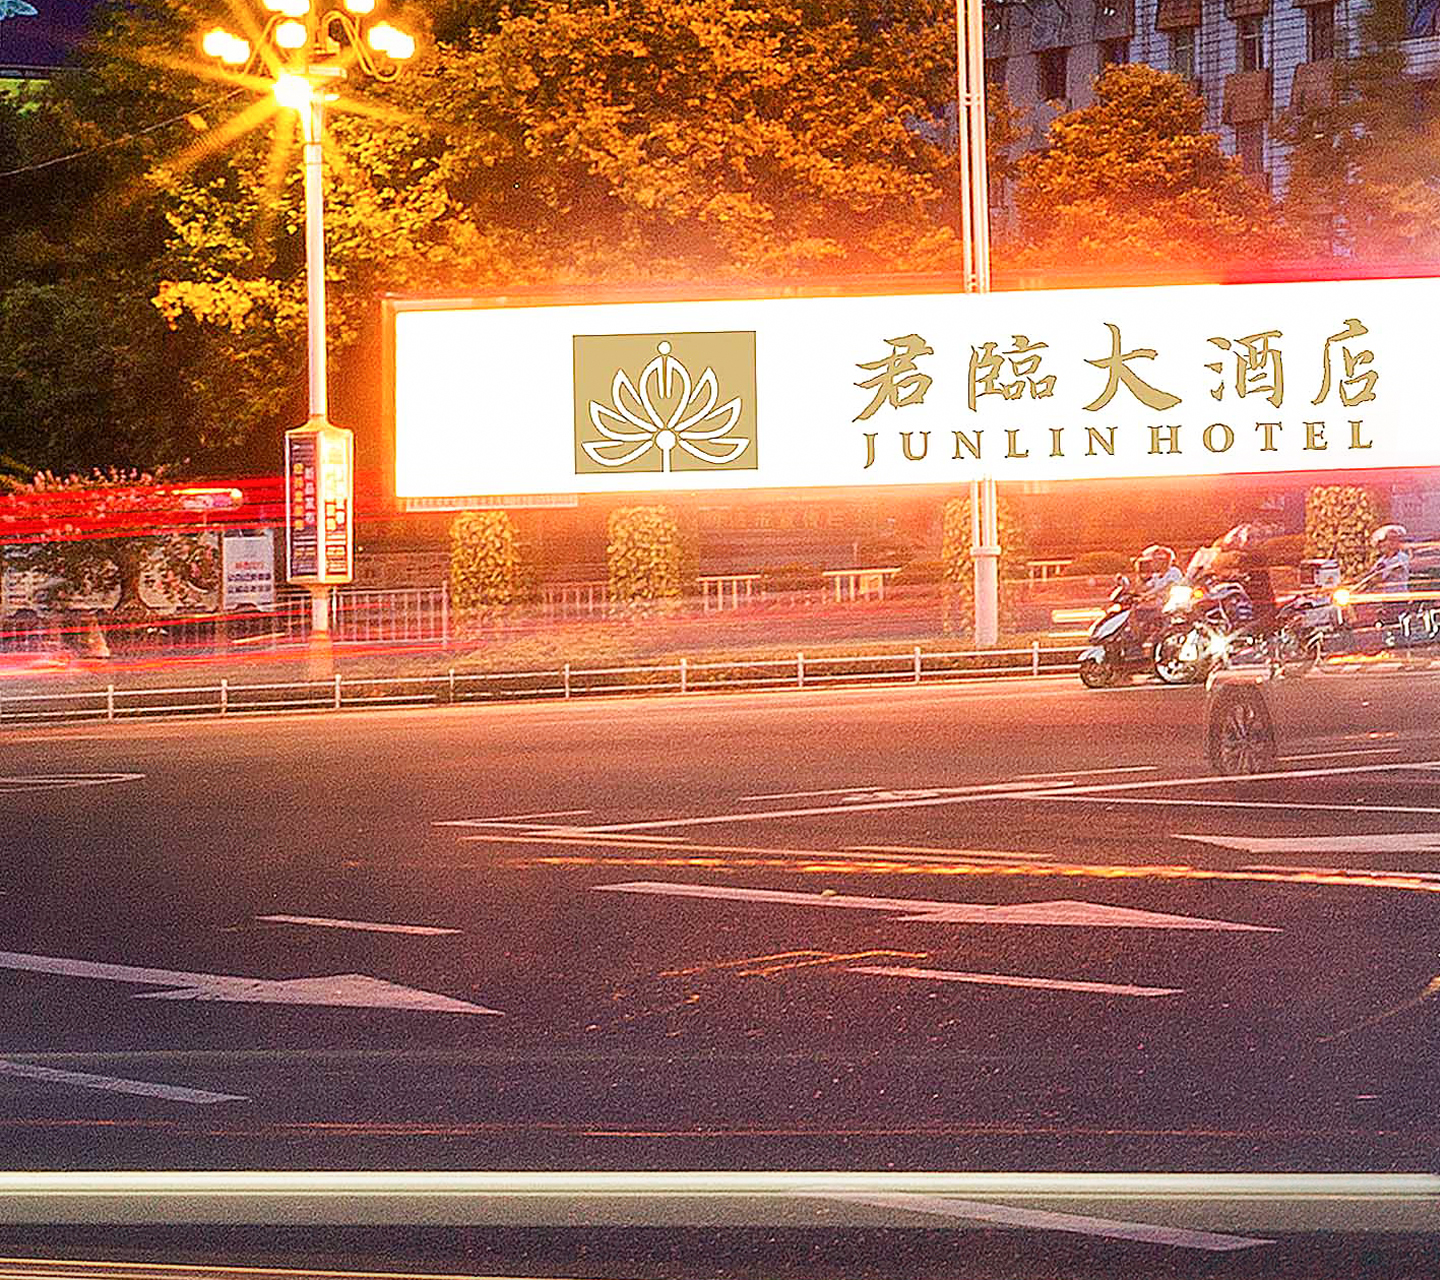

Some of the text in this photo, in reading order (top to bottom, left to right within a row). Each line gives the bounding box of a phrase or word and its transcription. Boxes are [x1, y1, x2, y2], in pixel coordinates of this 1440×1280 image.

[852, 318, 1379, 422] 君臨大酒店
[863, 419, 1374, 468] JUNLIN HOTEL
